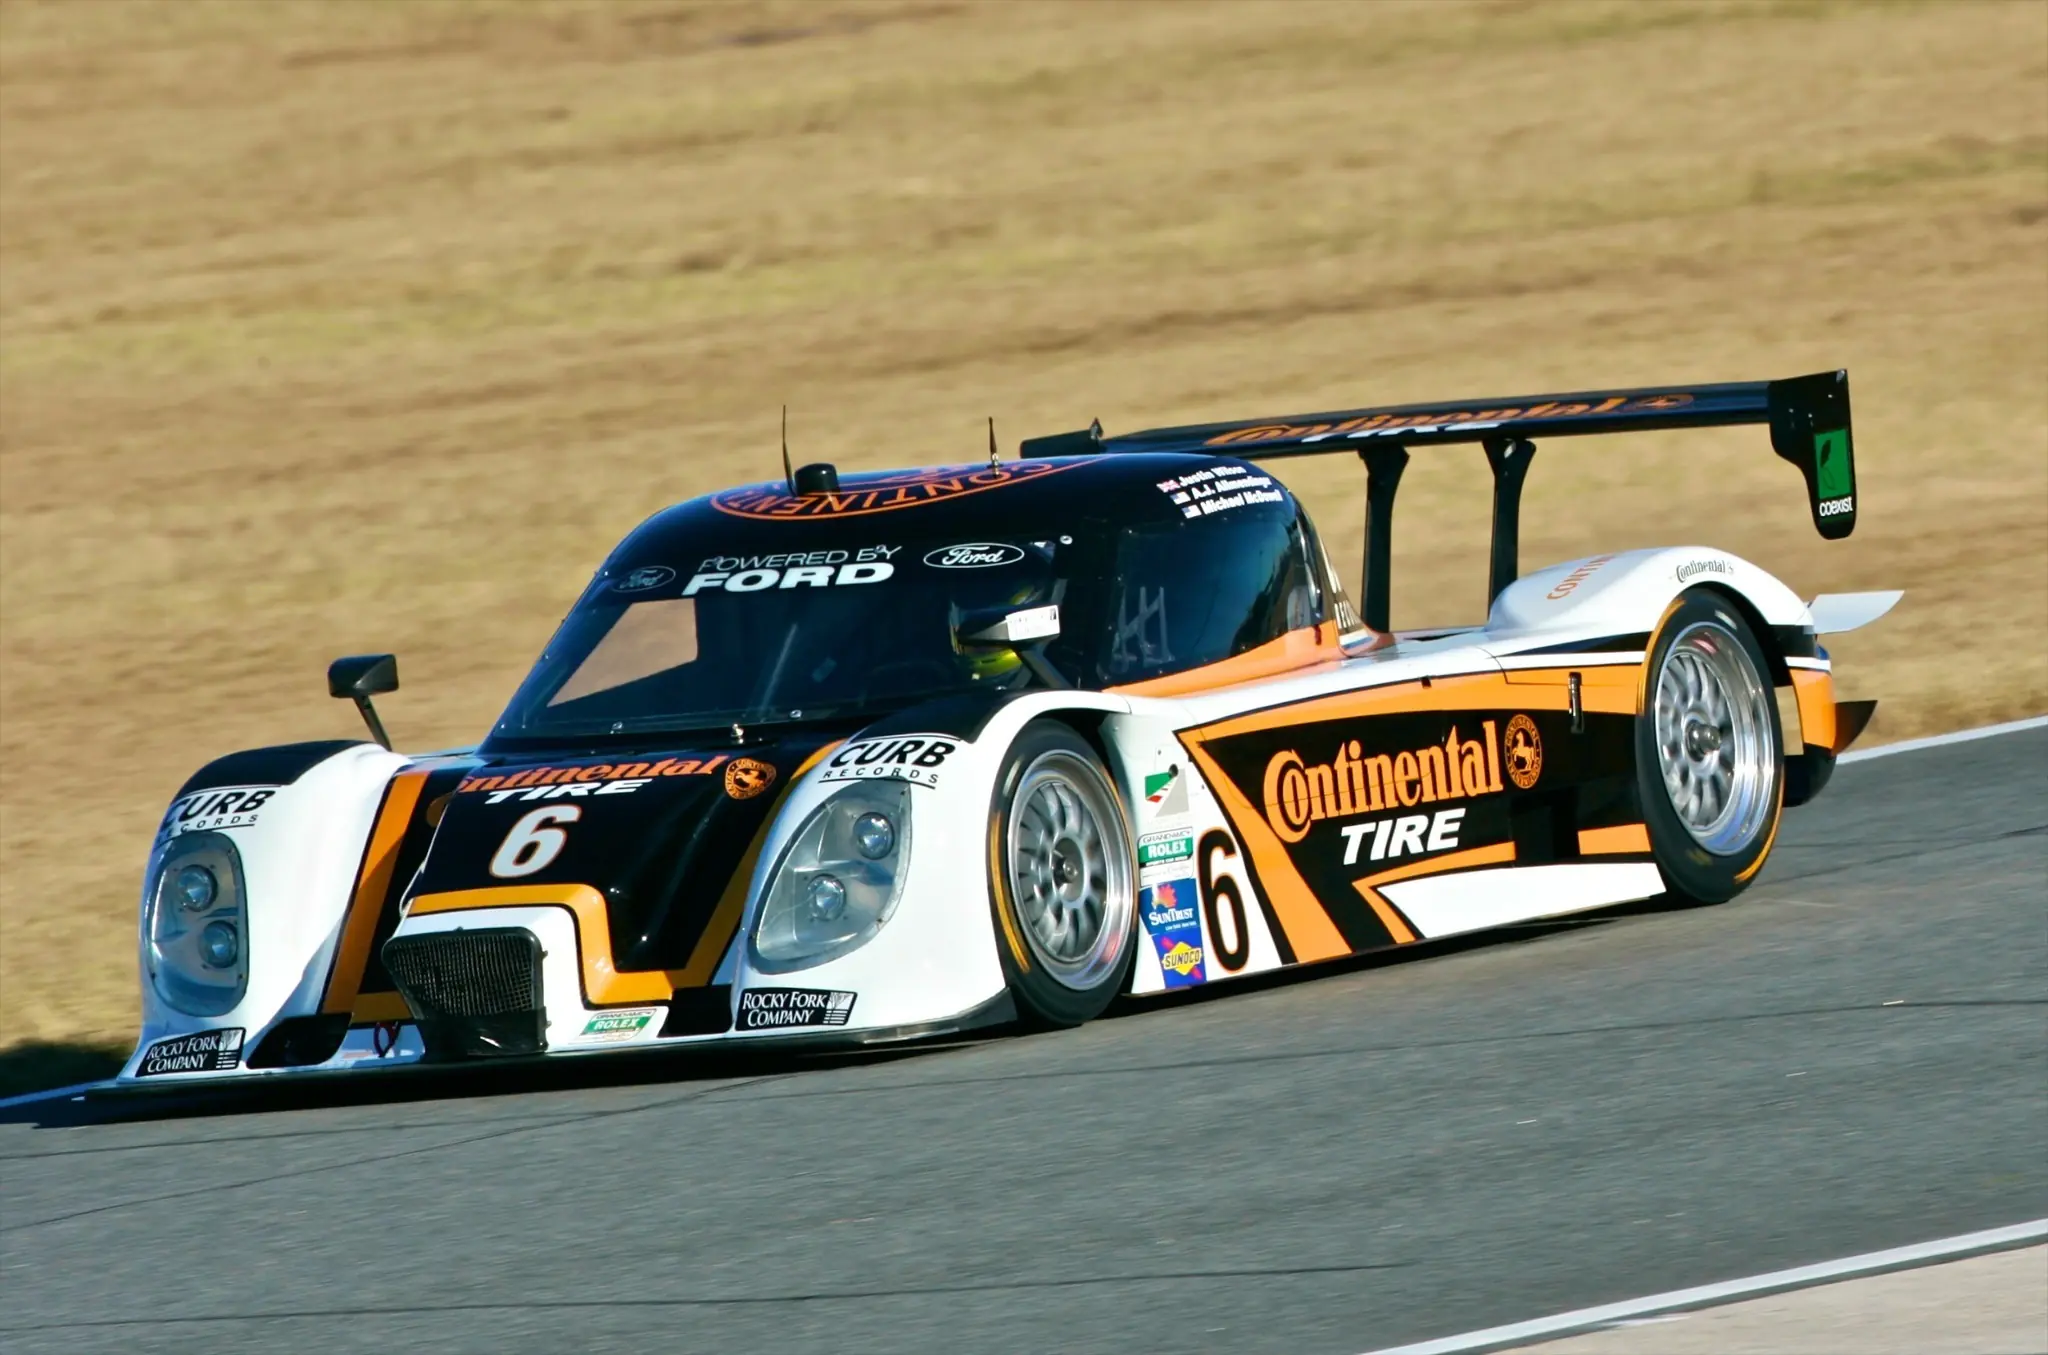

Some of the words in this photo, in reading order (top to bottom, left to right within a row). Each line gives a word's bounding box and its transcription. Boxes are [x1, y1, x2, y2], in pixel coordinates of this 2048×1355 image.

[698, 550, 849, 573] POWERED
[856, 545, 902, 562] BY
[942, 546, 1005, 566] Ford
[681, 562, 895, 596] FORD
[1676, 559, 1727, 584] Continental
[829, 739, 957, 769] CURB
[823, 766, 940, 785] RECORDS
[1262, 719, 1505, 844] Continental
[485, 778, 653, 805] TIRE
[161, 789, 277, 829] CURB
[489, 803, 583, 879] 6
[1340, 807, 1467, 866] TIRE
[1147, 840, 1188, 859] ROLEX
[1197, 826, 1251, 975] 6
[1164, 949, 1200, 968] SUNOCO
[742, 992, 789, 1011] ROCKY
[788, 991, 828, 1009] FORK
[593, 1017, 640, 1031] ROLEX
[747, 1009, 815, 1027] COMPANY
[147, 1040, 189, 1060] ROCKY
[186, 1035, 220, 1053] FORK
[147, 1053, 208, 1073] COMPANY
